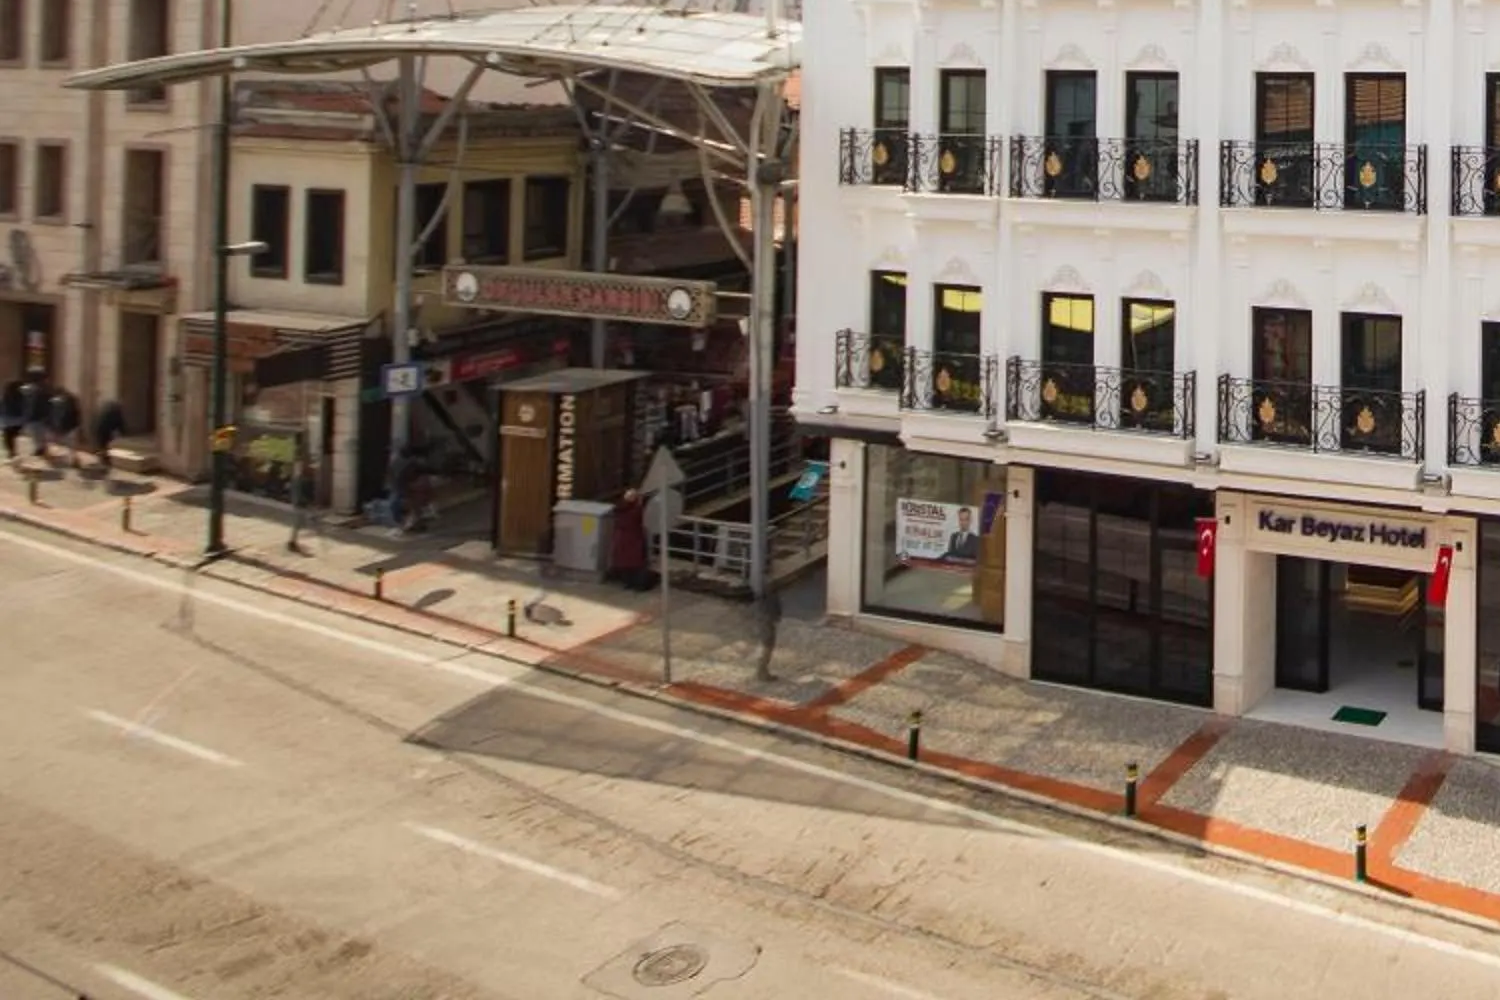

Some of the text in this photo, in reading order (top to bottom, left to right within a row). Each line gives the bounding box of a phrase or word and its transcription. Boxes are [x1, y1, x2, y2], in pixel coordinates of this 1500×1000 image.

[557, 394, 577, 499] RMATION
[1258, 510, 1426, 549] Kar Beyaz Hotel
